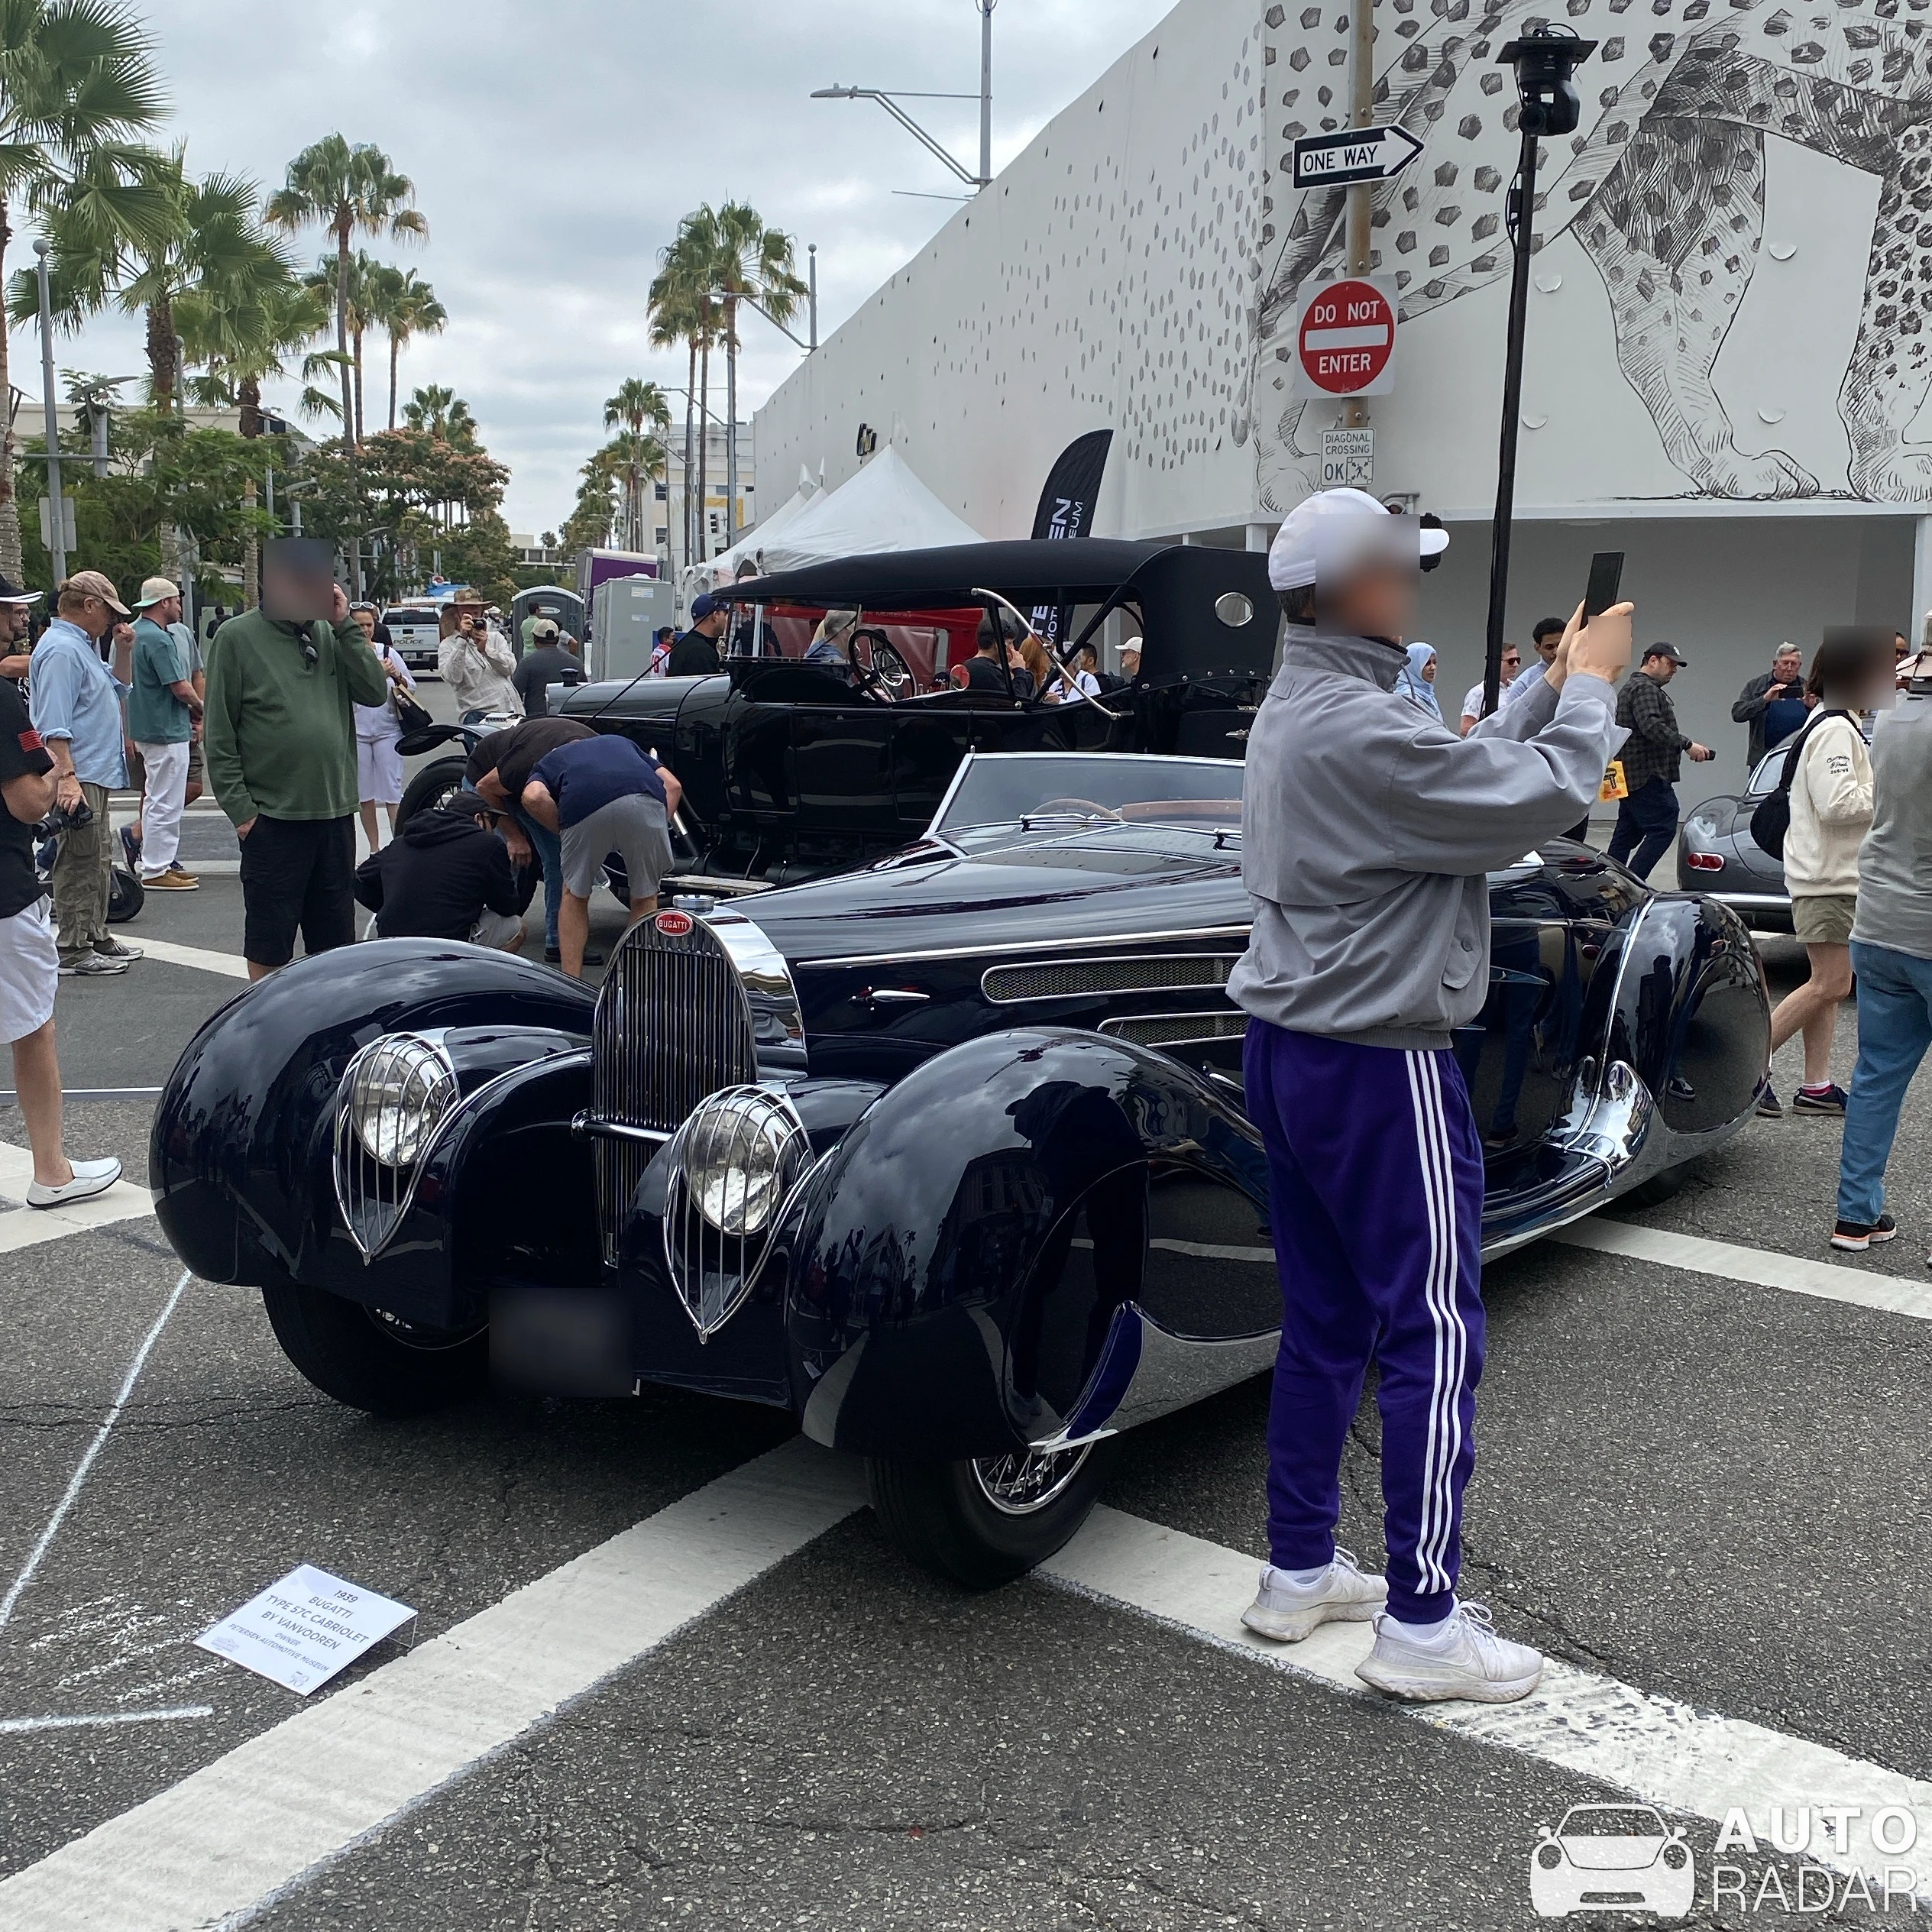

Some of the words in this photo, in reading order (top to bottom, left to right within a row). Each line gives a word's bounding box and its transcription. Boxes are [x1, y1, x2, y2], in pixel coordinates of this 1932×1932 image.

[1303, 151, 1335, 173] ONE
[1343, 145, 1379, 167] WAY
[1314, 304, 1337, 324] DO
[1347, 300, 1380, 321] NOT
[1318, 353, 1371, 374] ENTER
[1325, 432, 1371, 443] DIAGONAL
[1325, 445, 1370, 455] CROSSING
[1325, 463, 1344, 481] OK
[659, 919, 688, 930] BUGATTI
[307, 1596, 354, 1619] BUGATTI
[333, 1590, 359, 1604] 1939
[265, 1594, 291, 1610] TYPE
[290, 1605, 310, 1620] 57C
[309, 1614, 370, 1644] CABRIOLET
[261, 1611, 277, 1621] BY
[276, 1616, 341, 1650] VANVOOREN
[274, 1633, 301, 1647] OWNER
[228, 1623, 261, 1641] PETERSEN
[259, 1637, 302, 1659] AUTOMOTIVE
[299, 1655, 331, 1672] MUSEUM
